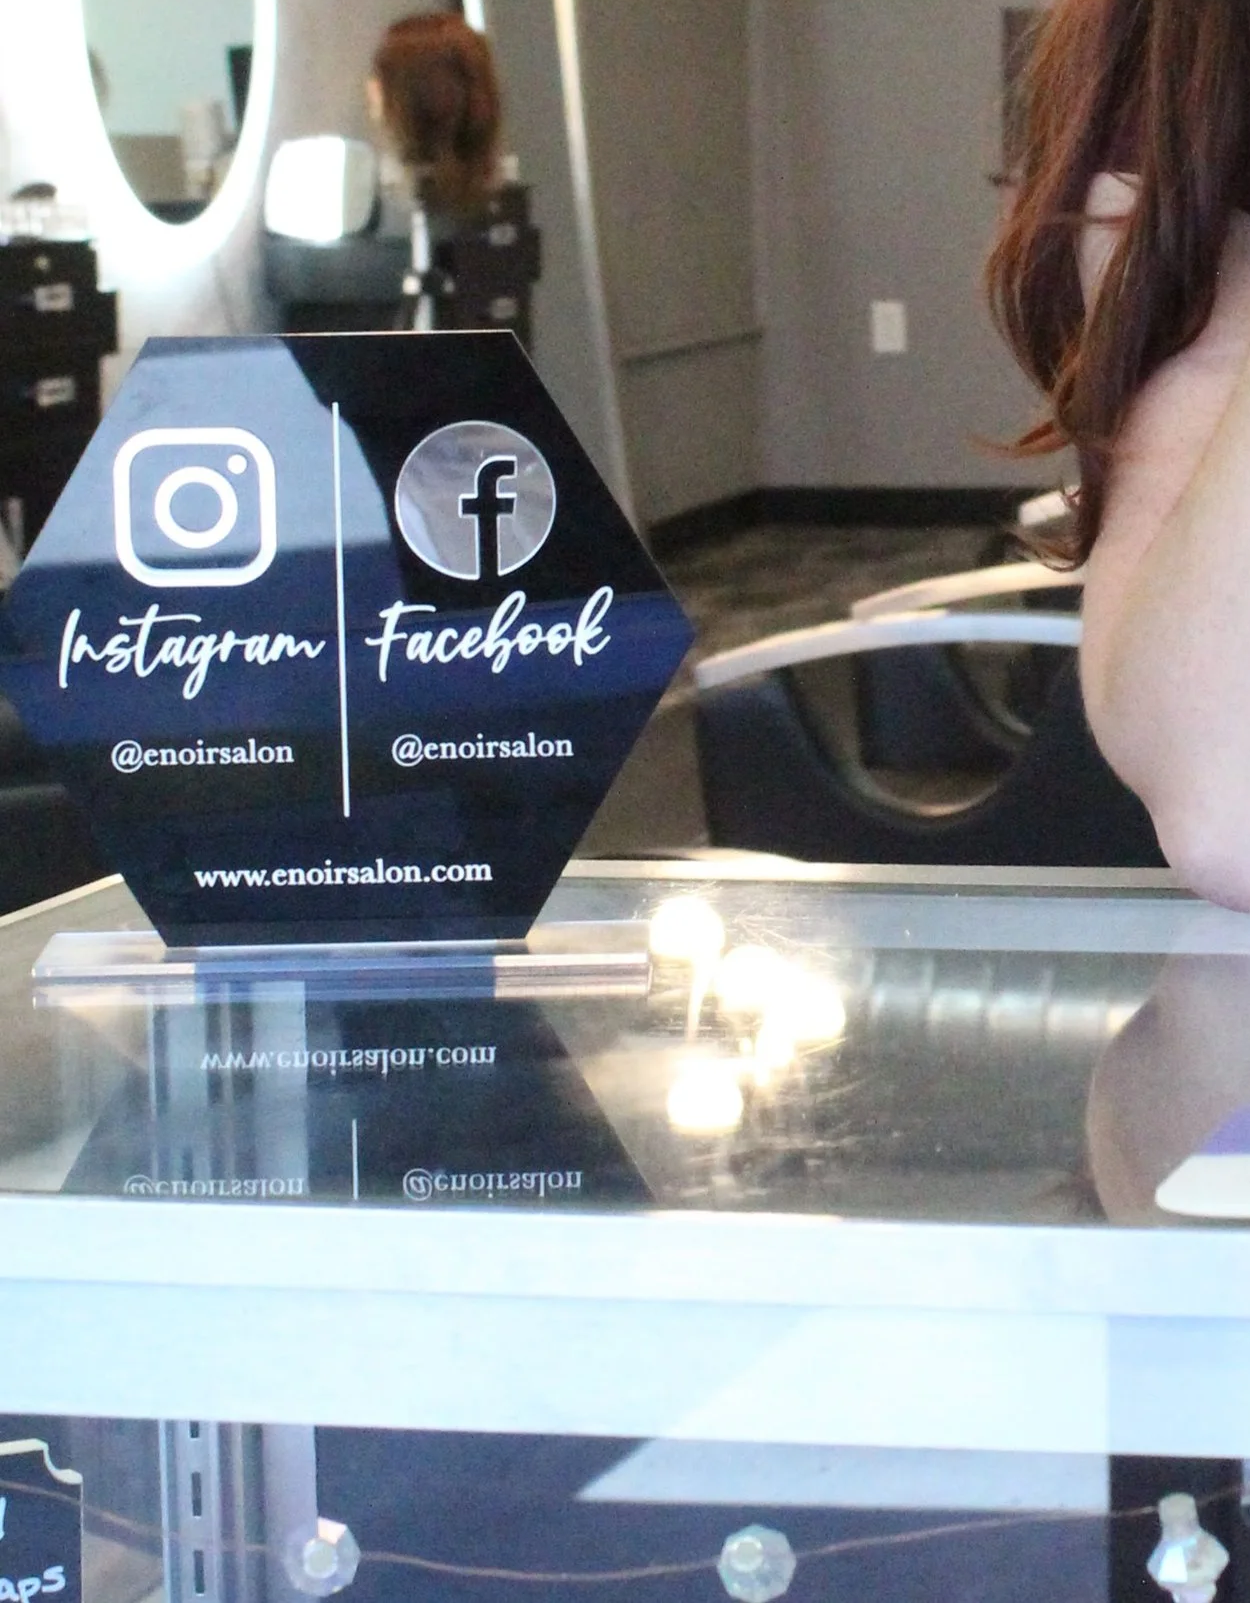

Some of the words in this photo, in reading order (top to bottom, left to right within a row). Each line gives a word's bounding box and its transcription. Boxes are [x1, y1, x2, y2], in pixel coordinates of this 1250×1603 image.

[365, 586, 613, 682] Facebook
[59, 605, 326, 699] Instagram
[111, 739, 295, 773] @enoirsalon
[391, 733, 574, 768] @enoirsalon
[194, 859, 493, 889] www.enoirsalon.com
